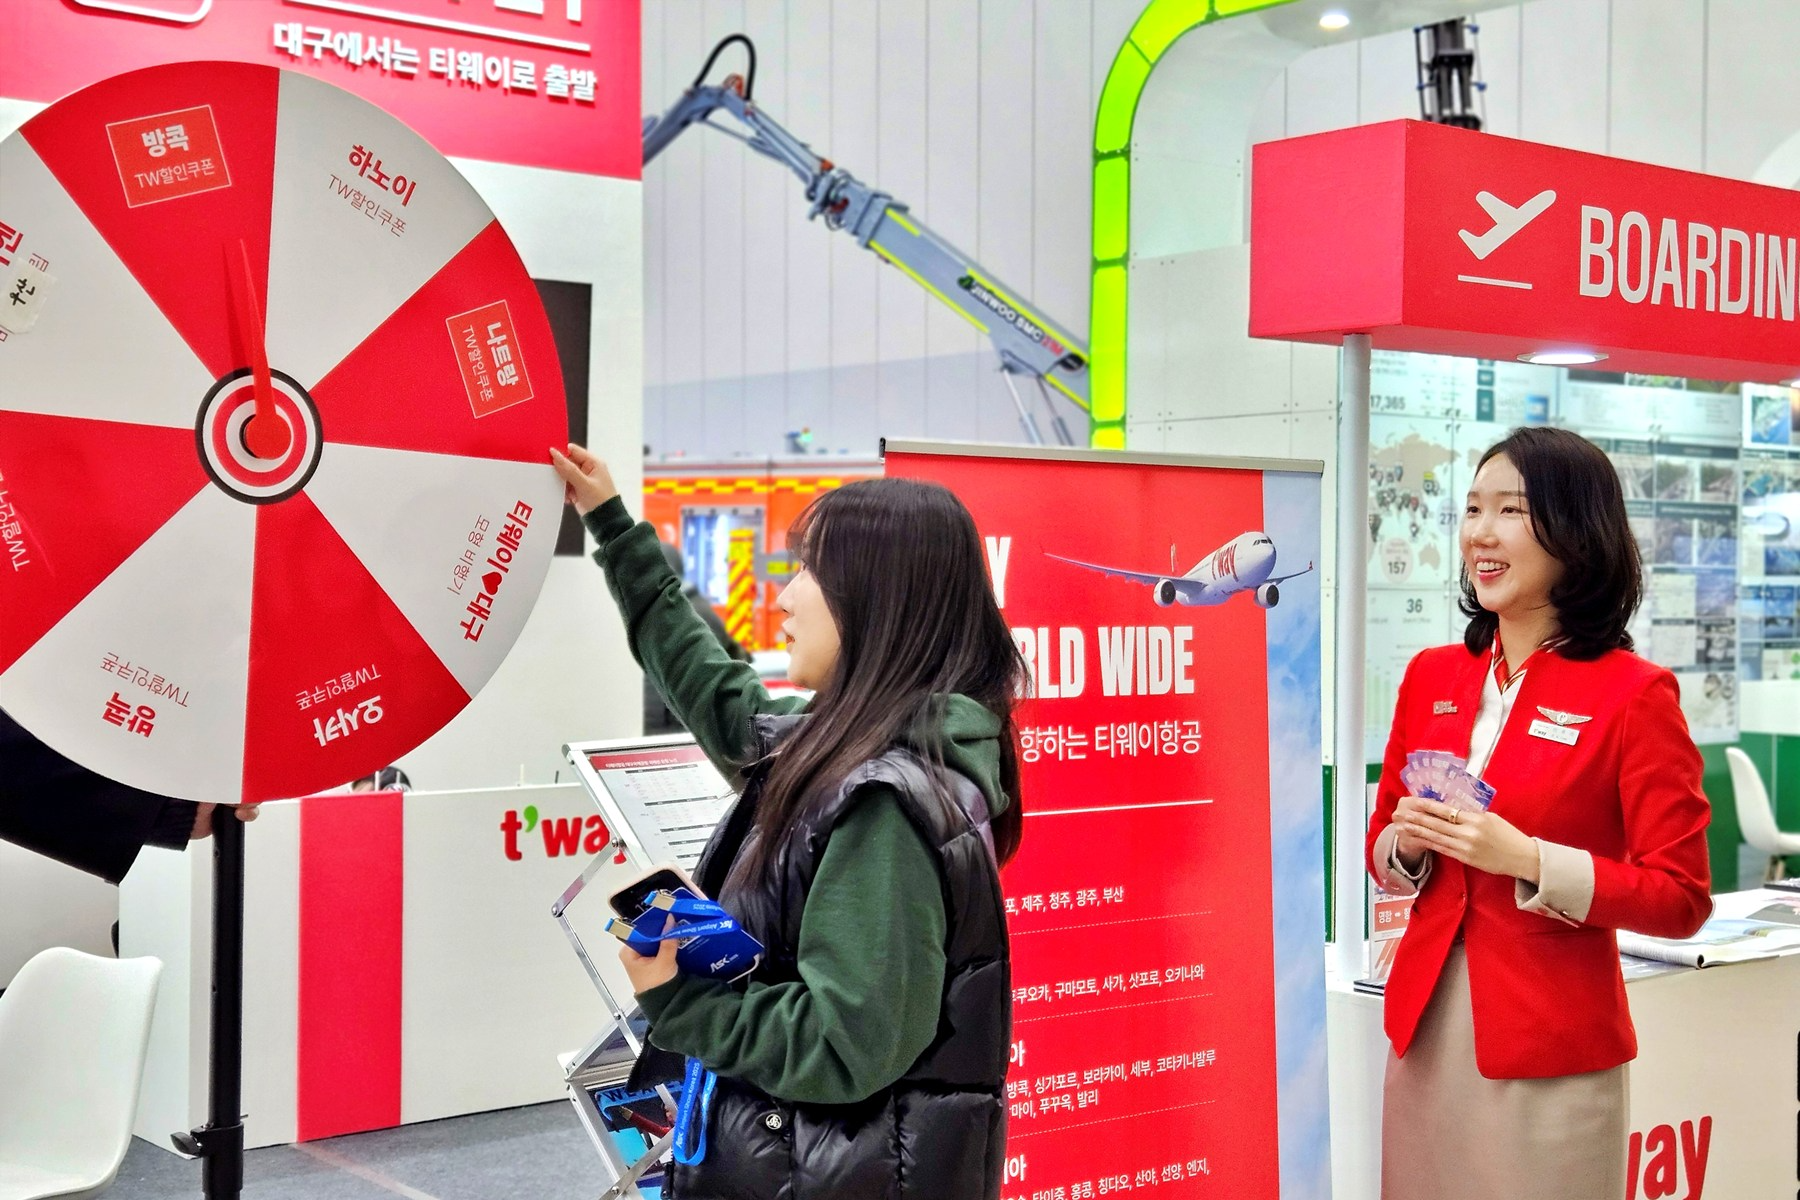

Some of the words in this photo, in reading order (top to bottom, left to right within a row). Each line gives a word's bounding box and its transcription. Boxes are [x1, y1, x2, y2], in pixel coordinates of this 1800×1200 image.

[273, 23, 420, 74] 대구에서는
[429, 47, 537, 90] 티웨이로
[543, 63, 597, 101] 출발
[141, 124, 189, 157] 방콕
[134, 158, 216, 188] TW할인쿠폰
[348, 144, 417, 207] 하노이
[328, 173, 407, 237] TW할인쿠폰
[1580, 204, 1800, 322] BOARDIN
[462, 324, 495, 402] TW할인쿠폰
[486, 322, 519, 387] 나트랑
[0, 468, 30, 572] TW할인
[467, 514, 491, 548] 모형
[446, 549, 477, 596] 비행기
[1388, 561, 1407, 574] 157
[1406, 598, 1423, 613] 36
[100, 651, 190, 708] TW할인쿠폰
[1010, 626, 1085, 699] RLD
[1097, 625, 1195, 697] WIDE
[295, 663, 382, 711] TW할인쿠폰
[102, 691, 156, 738] 방콕
[312, 695, 384, 747] 오사카
[1019, 722, 1089, 763] 향하는
[1094, 720, 1202, 758] 티웨이항공
[500, 805, 627, 865] t'wa
[1004, 897, 1019, 916] 포,
[1021, 894, 1046, 913] 제주,
[1048, 891, 1074, 910] 청주,
[1075, 888, 1101, 907] 광주,
[1102, 886, 1124, 904] 부산
[1054, 979, 1100, 1000] 구마모토,
[1101, 974, 1126, 993] 사가,
[1128, 970, 1162, 989] 삿포로,
[1164, 963, 1205, 984] 오키나와
[692, 1062, 700, 1077] 2025
[1006, 1080, 1032, 1099] 방콕,
[1034, 1071, 1080, 1094] 싱가포르,
[1083, 1063, 1128, 1085] 보라카이,
[1129, 1059, 1154, 1078] 세부,
[1156, 1048, 1217, 1073] 코타키나발루
[1009, 1040, 1026, 1067] 아
[1009, 1100, 1037, 1120] 마이,
[1038, 1094, 1074, 1115] 푸꾸옥,
[1076, 1089, 1099, 1109] 발리
[1003, 1153, 1027, 1185] 아
[1070, 1180, 1095, 1200] 홍콩,
[1097, 1174, 1132, 1196] 칭다오,
[1134, 1168, 1159, 1188] 산야,
[1160, 1164, 1185, 1183] 선양,
